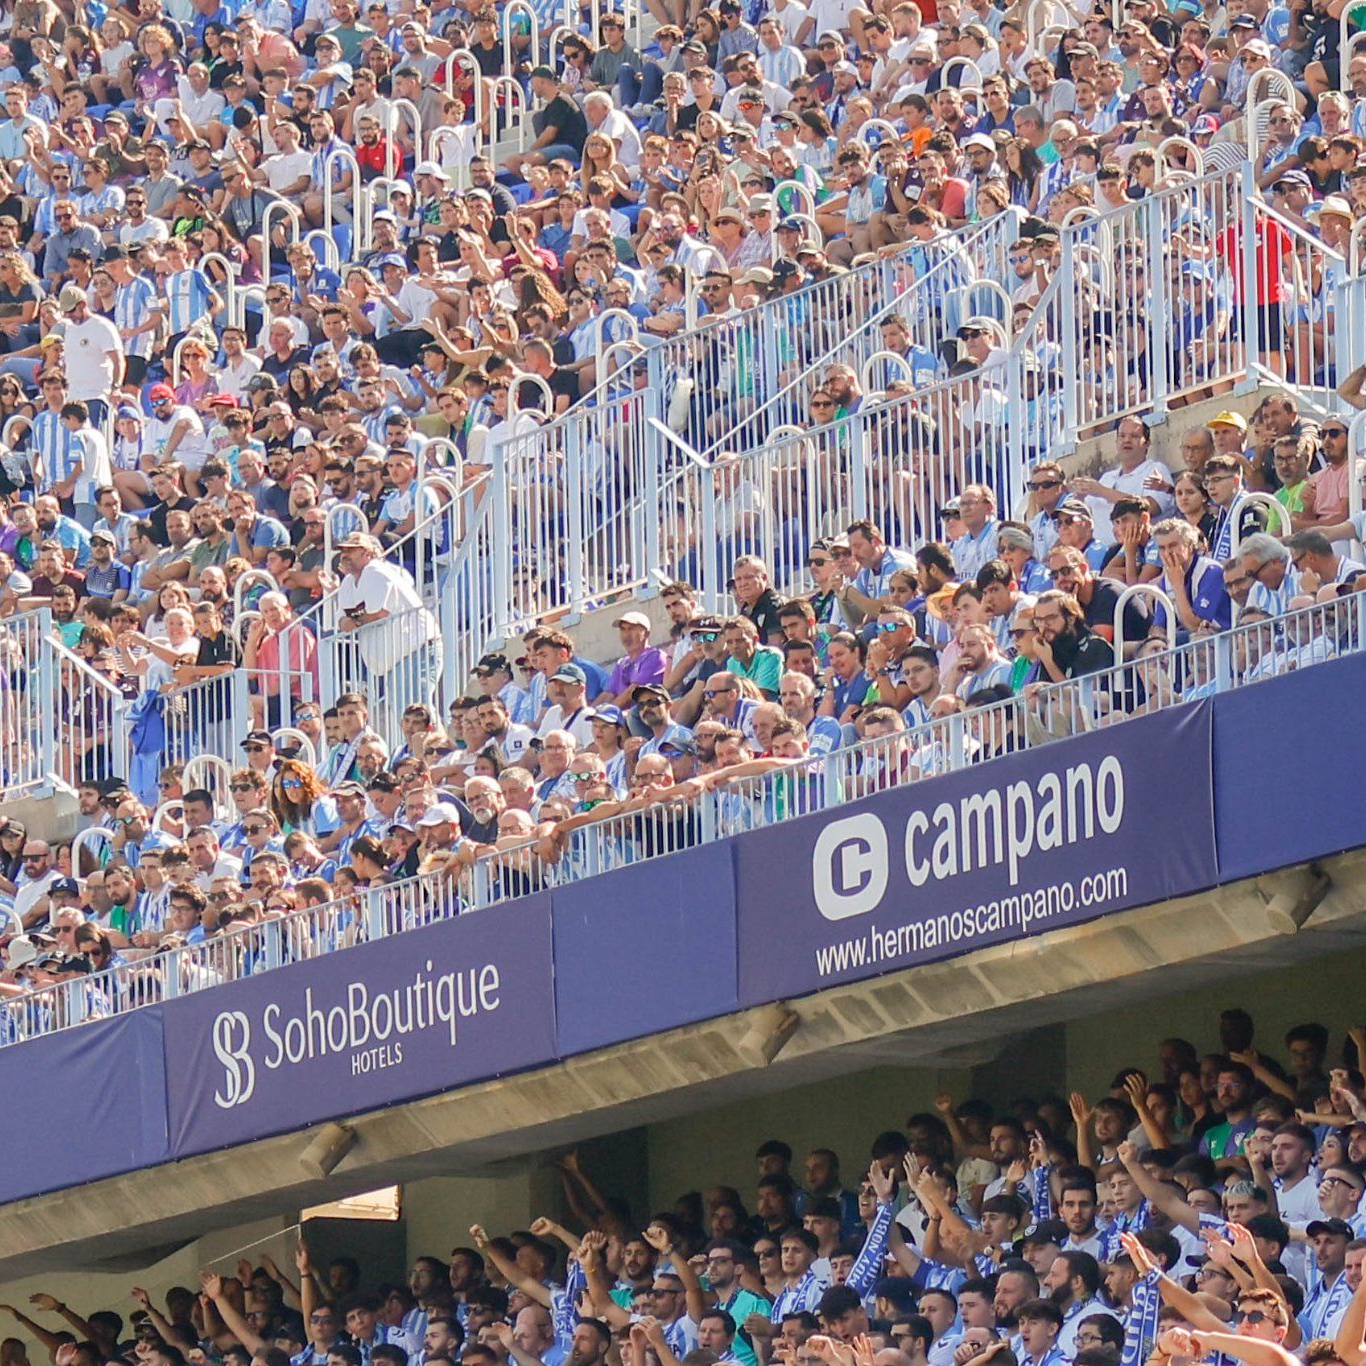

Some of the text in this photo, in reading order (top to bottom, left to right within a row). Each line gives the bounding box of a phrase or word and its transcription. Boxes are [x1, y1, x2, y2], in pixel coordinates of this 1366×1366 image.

[905, 755, 1125, 886] campano
[816, 865, 1129, 976] www.hermanoscampano.com
[264, 959, 499, 1071] SohoBoutique
[351, 1042, 403, 1076] HOTELS
